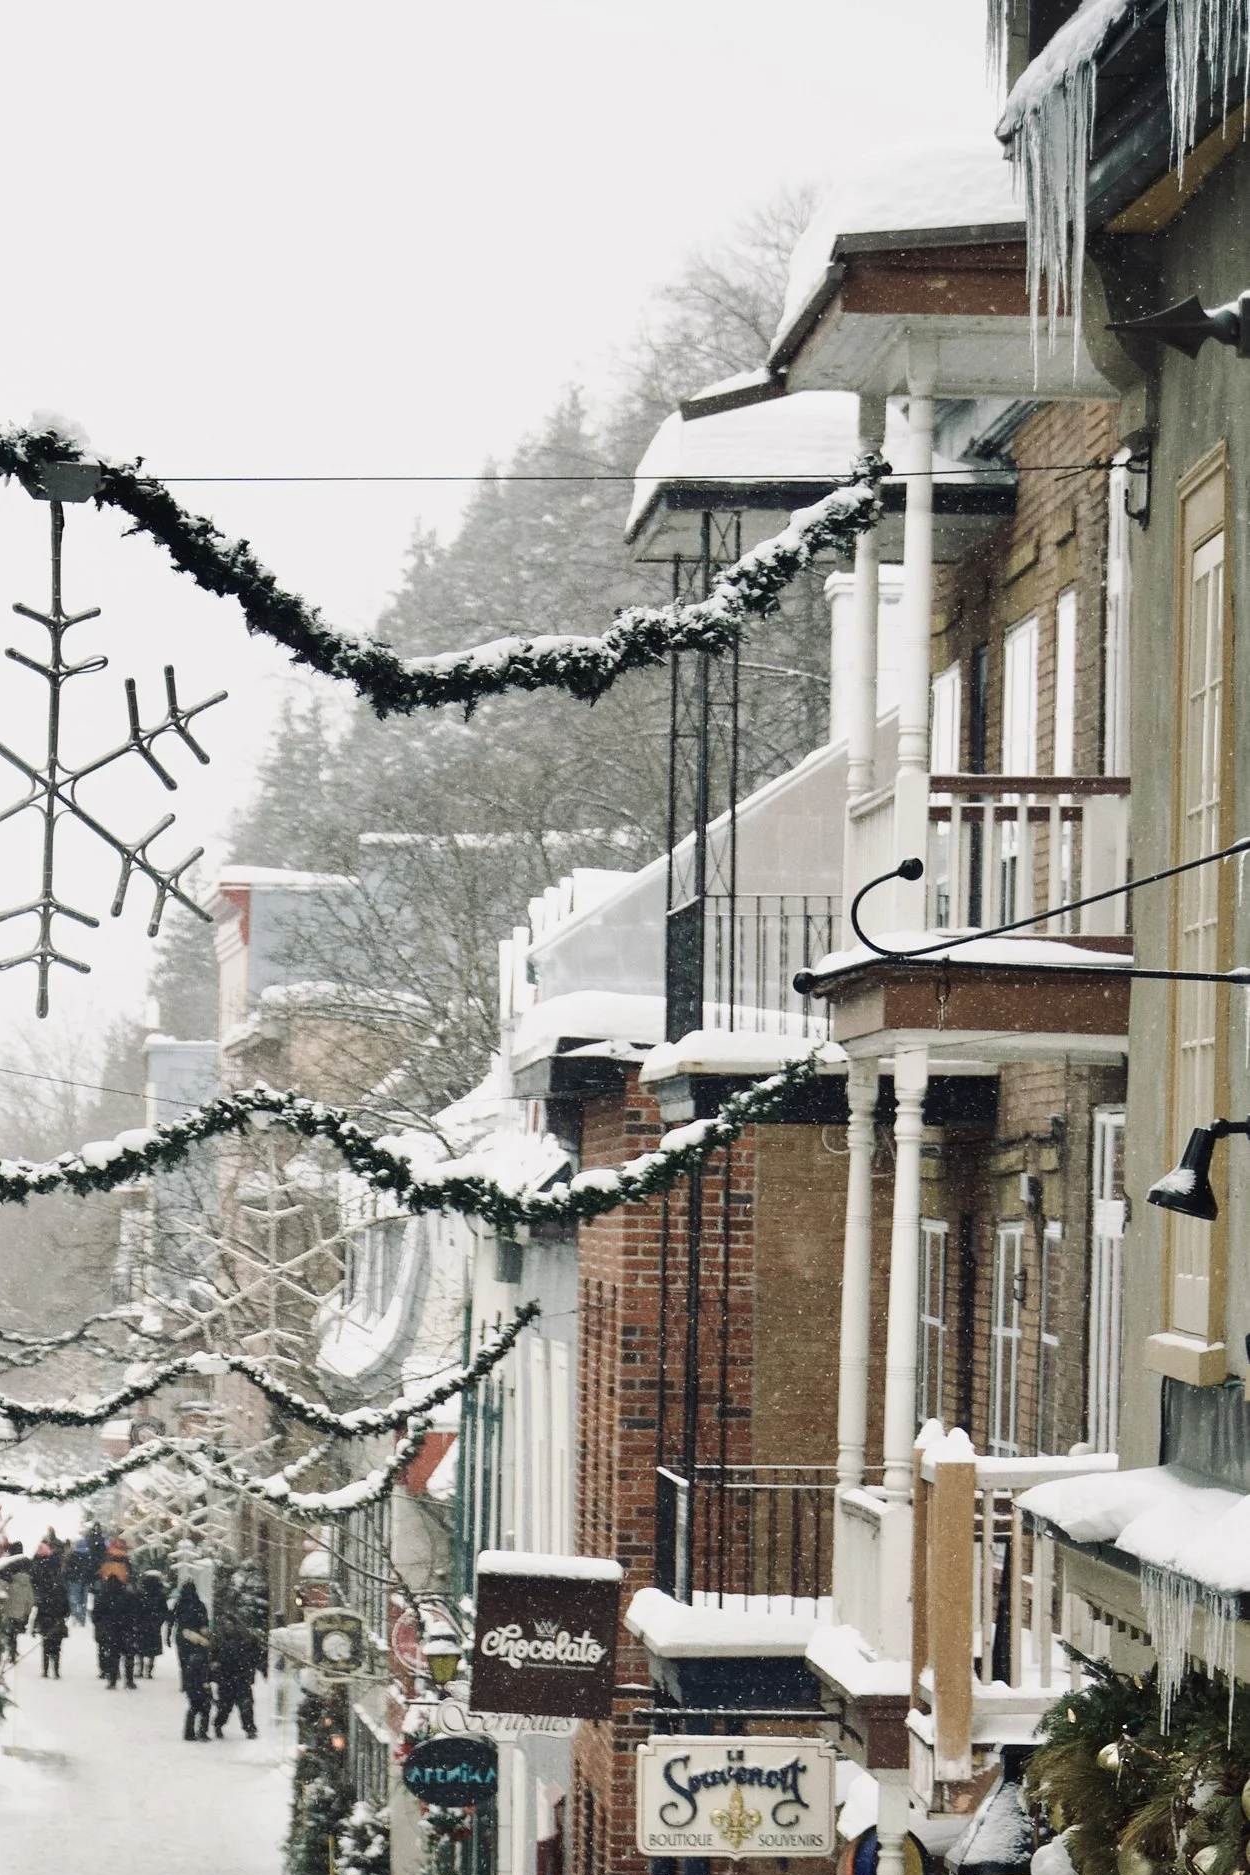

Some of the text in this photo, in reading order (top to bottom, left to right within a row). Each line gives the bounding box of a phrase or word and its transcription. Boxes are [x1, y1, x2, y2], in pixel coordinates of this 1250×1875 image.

[481, 1623, 608, 1669] Chocolato
[649, 1833, 824, 1847] BOUTIQUE SOUVENIRS
